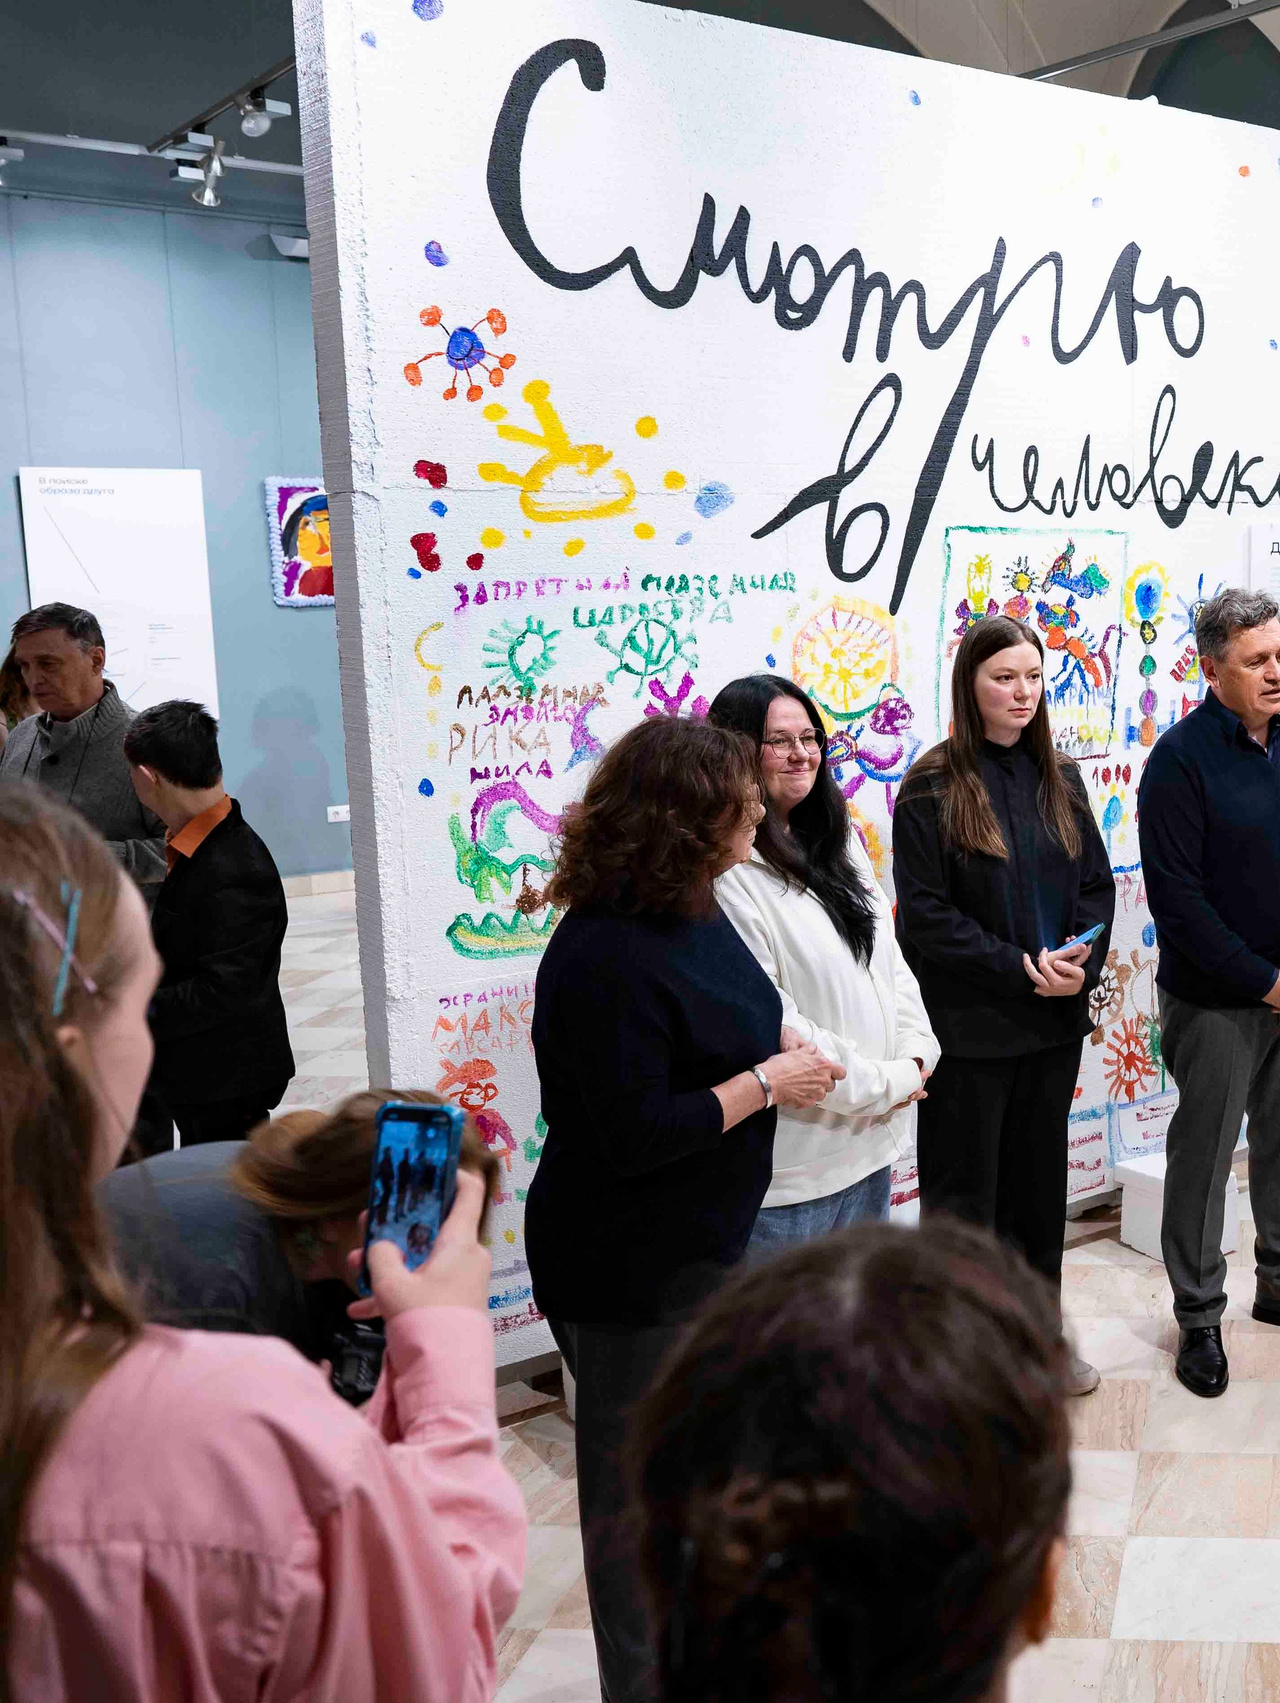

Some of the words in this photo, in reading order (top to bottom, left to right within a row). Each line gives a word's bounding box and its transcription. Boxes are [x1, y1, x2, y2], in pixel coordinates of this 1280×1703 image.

[487, 38, 1204, 616] Смотрю
[751, 372, 902, 583] в
[448, 723, 552, 766] РИКА
